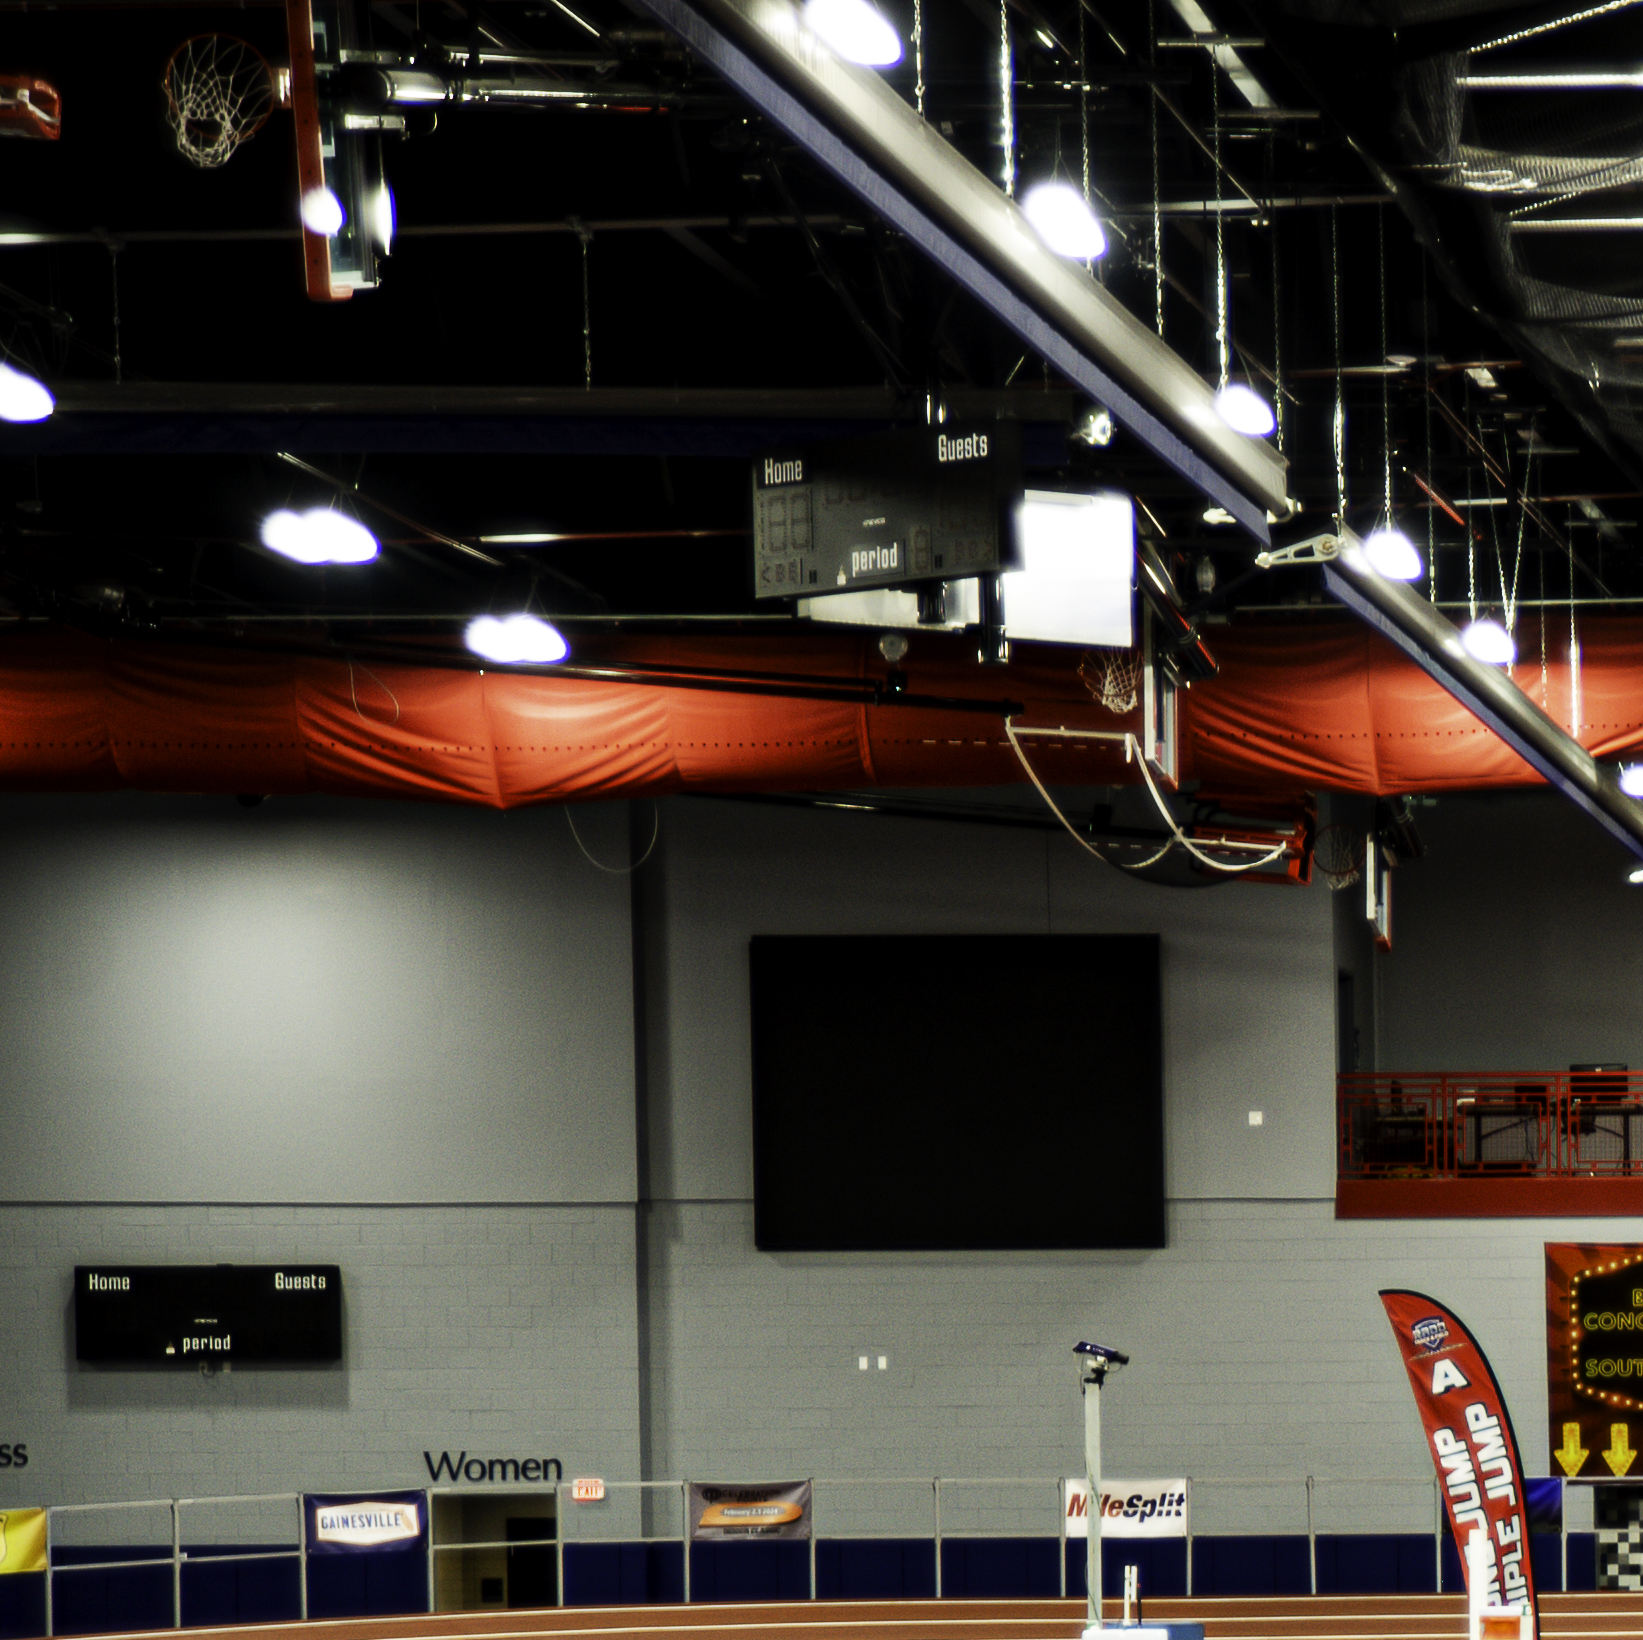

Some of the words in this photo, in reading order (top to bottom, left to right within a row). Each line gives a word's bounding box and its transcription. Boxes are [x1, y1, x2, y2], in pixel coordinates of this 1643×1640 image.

[764, 458, 802, 485] Home
[937, 432, 988, 463] Guests
[851, 541, 899, 578] period
[88, 1272, 131, 1291] Home
[274, 1272, 327, 1290] Guests
[182, 1334, 231, 1353] period
[1432, 1358, 1472, 1396] A
[424, 1451, 562, 1481] Women
[1465, 1402, 1518, 1507] JUMP
[1433, 1428, 1490, 1531] JUMP
[320, 1512, 402, 1531] GAINESVILLE
[1067, 1492, 1185, 1523] MleSplit
